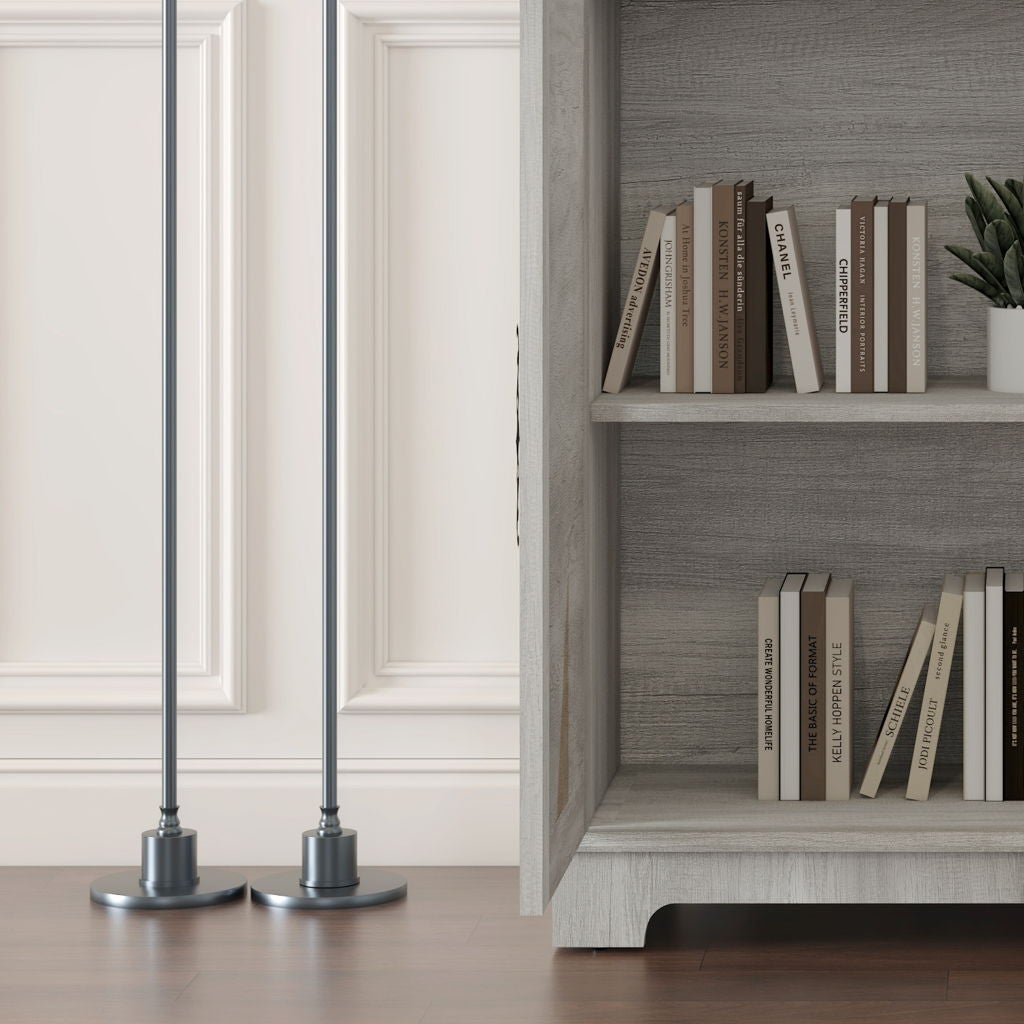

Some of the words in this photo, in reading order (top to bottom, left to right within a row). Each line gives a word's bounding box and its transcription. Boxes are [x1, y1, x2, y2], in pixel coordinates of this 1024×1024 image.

[736, 191, 744, 215] saum
[682, 223, 690, 233] At
[736, 217, 745, 234] für
[682, 237, 691, 262] Home
[718, 220, 729, 281] KONSTEN
[736, 235, 745, 252] alla
[774, 223, 792, 281] CHANEL
[632, 246, 653, 293] AVEDON
[682, 264, 690, 274] in
[736, 253, 745, 270] die
[911, 236, 920, 289] KONSTEN
[680, 275, 691, 306] Joshua
[736, 271, 745, 312] sünderin
[838, 258, 849, 334] CHIPPERFIELD
[615, 294, 639, 350] advertising
[682, 307, 690, 328] Tree
[717, 288, 729, 369] H.W.JANSON
[764, 638, 773, 666] CREATE
[808, 635, 818, 679] FORMAT
[831, 642, 842, 676] STYLE
[935, 651, 945, 680] second
[764, 667, 773, 713] WONDERFUL
[808, 682, 818, 696] OF
[831, 679, 842, 725] HOPPEN
[808, 698, 818, 729] BASIC
[885, 685, 911, 738] SCHIELE
[922, 697, 939, 745] PICOULT
[764, 714, 773, 751] HOMELIFE
[808, 733, 817, 753] THE
[831, 728, 842, 763] KELLY
[917, 744, 930, 771] JODI
